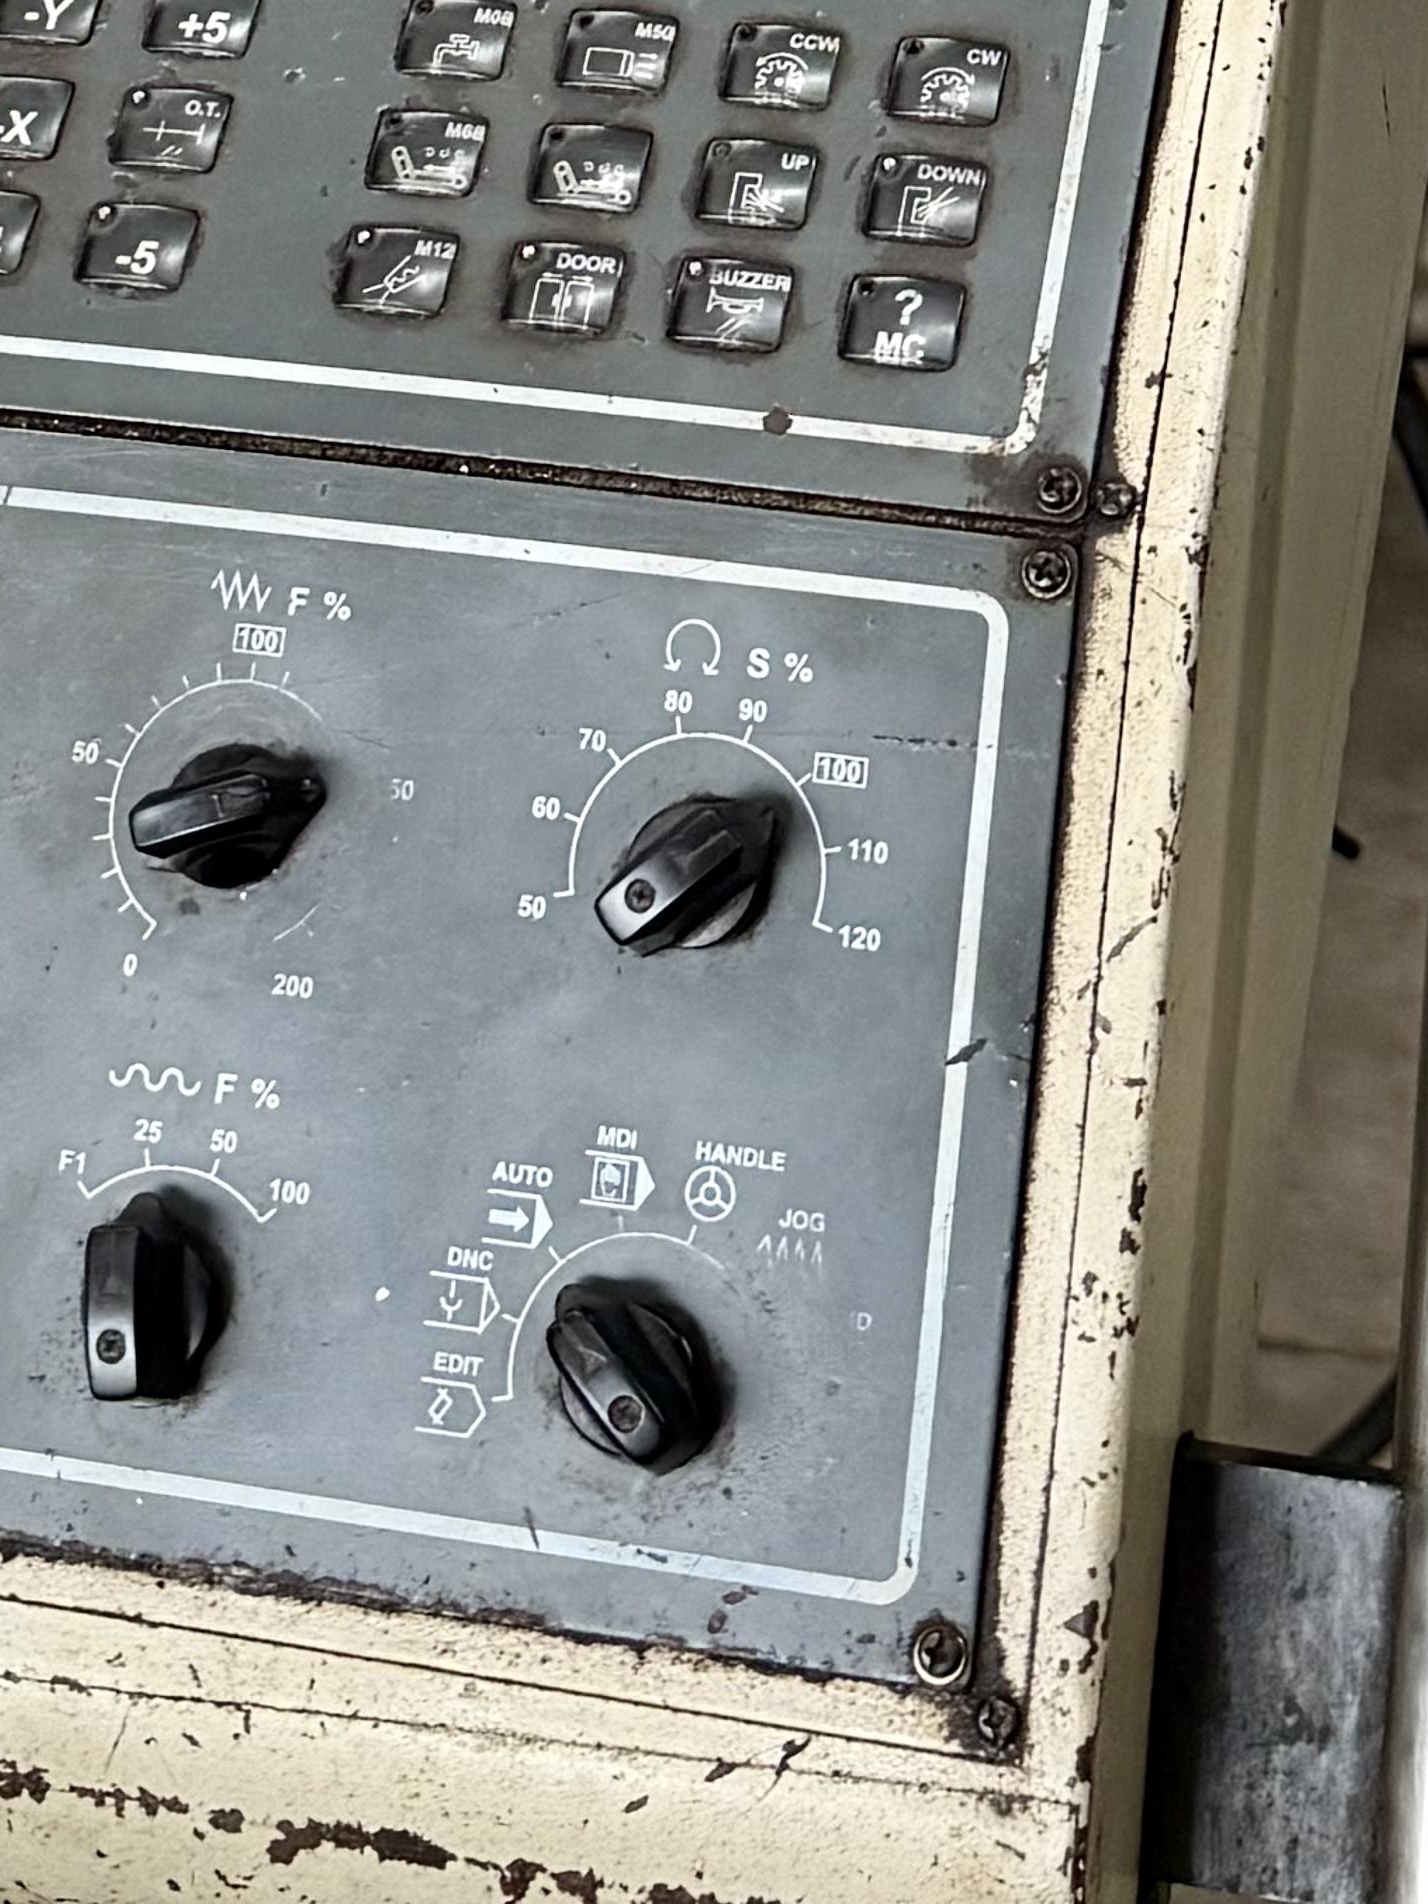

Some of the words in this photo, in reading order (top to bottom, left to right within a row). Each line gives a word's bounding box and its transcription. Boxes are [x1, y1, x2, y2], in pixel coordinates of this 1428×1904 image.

[178, 10, 231, 43] +5
[789, 33, 840, 53] CCW
[967, 49, 1001, 66] CW
[781, 153, 809, 170] UP
[917, 164, 982, 185] DOWN
[115, 240, 159, 274] -5
[556, 252, 617, 274] DOOR
[709, 269, 791, 291] BUZZER
[287, 587, 309, 616] F
[323, 592, 351, 620] %
[238, 628, 279, 652] 100
[746, 647, 770, 679] S
[784, 653, 814, 683] %
[664, 690, 692, 714] 80
[738, 698, 767, 722] 90
[71, 740, 100, 764] 50
[578, 728, 607, 753] 70
[818, 758, 862, 783] 100
[532, 796, 561, 821] 60
[847, 838, 889, 864] 110
[518, 895, 546, 920] 50
[837, 925, 882, 952] 120
[122, 953, 138, 977] 0
[271, 973, 314, 999] 200
[214, 1072, 238, 1104] F
[251, 1078, 281, 1109] %
[133, 1118, 163, 1143] 25
[210, 1129, 238, 1154] 50
[597, 1125, 638, 1150] MDI
[58, 1148, 86, 1174] F1
[694, 1140, 787, 1172] HANDLE
[492, 1161, 553, 1188] AUTO
[269, 1177, 311, 1205] 100
[778, 1208, 826, 1233] JOG
[447, 1246, 494, 1270] DNC
[433, 1351, 484, 1376] EDIT
